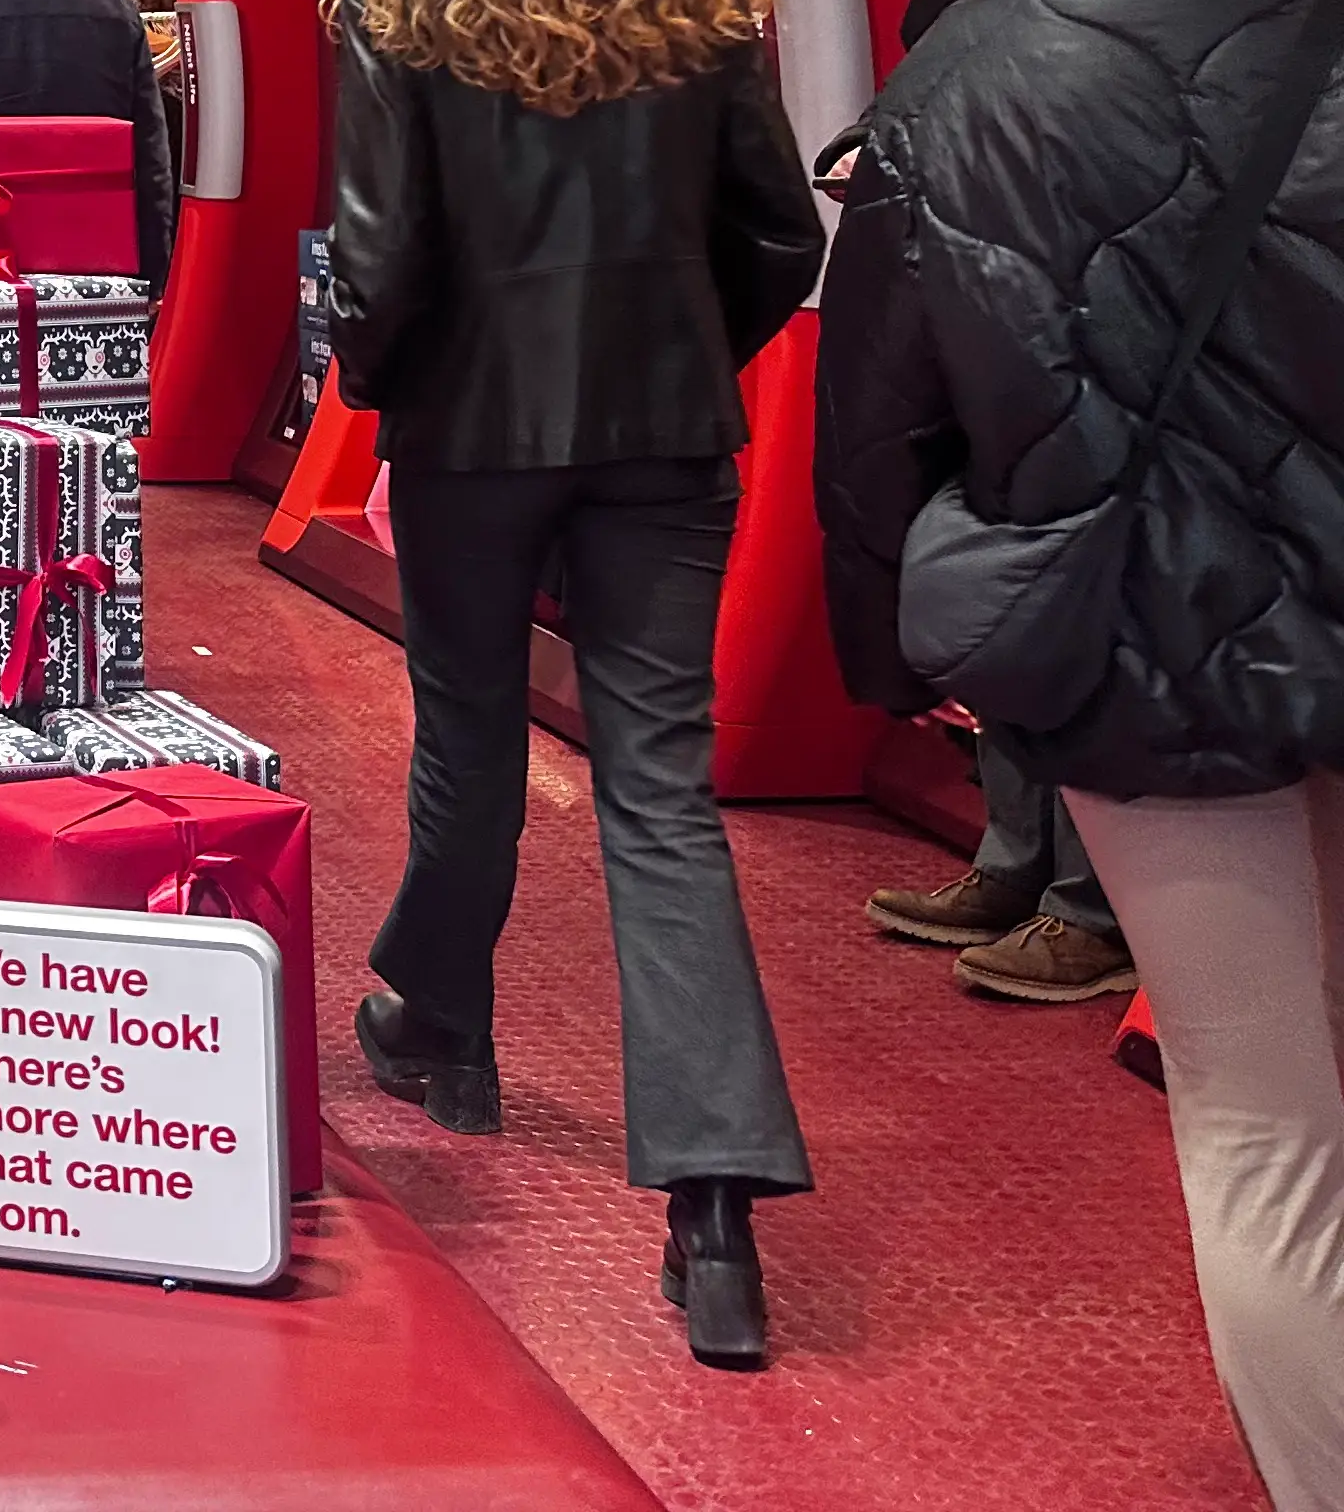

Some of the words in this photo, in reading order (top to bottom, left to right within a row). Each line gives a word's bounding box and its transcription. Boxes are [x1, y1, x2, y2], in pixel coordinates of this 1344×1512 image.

[42, 953, 148, 997] have
[1, 1007, 94, 1042] new
[110, 1007, 220, 1053] look!
[92, 1108, 237, 1154] where
[66, 1159, 194, 1200] came
